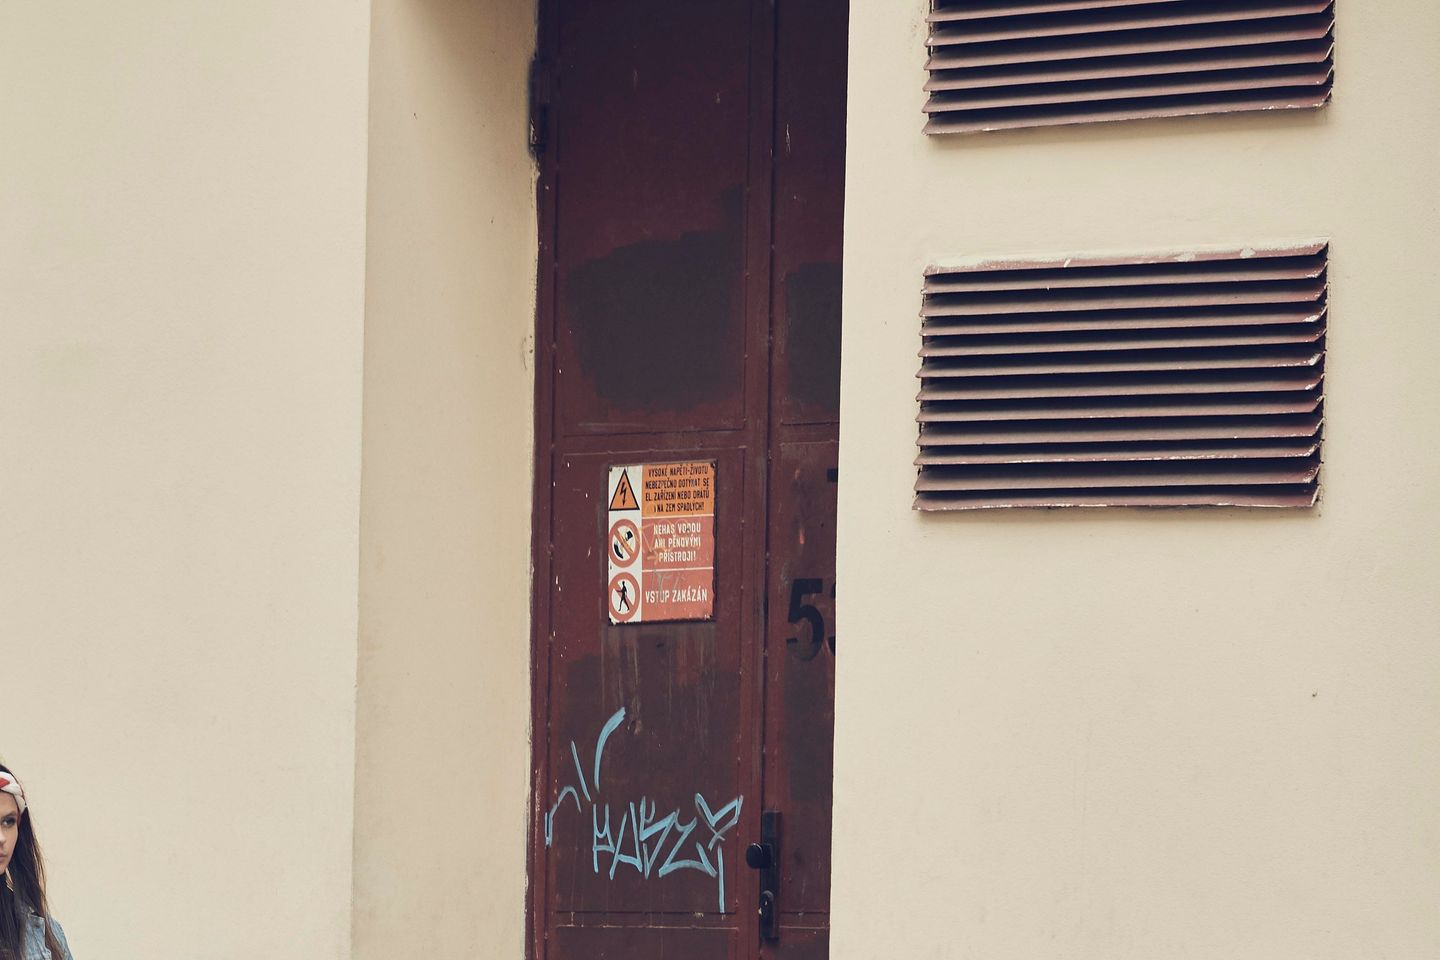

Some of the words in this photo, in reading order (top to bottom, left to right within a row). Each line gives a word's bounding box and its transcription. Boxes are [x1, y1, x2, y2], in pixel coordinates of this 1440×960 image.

[648, 465, 667, 477] VYSOKÉ
[645, 477, 677, 489] NEBEZPEČNO
[703, 478, 710, 487] SE
[654, 489, 676, 501] ZAŘÍZENÍ
[677, 491, 691, 500] NEBO
[657, 503, 663, 512] NA
[665, 503, 675, 512] ZEM
[653, 524, 675, 535] NEHAS
[677, 522, 701, 534] VODOU
[654, 538, 666, 549] ANI
[668, 534, 701, 549] PĚNOVÝMI
[645, 590, 669, 603] VSTUP
[672, 585, 708, 603] ZAKÁZÁN
[786, 578, 836, 661] 5
